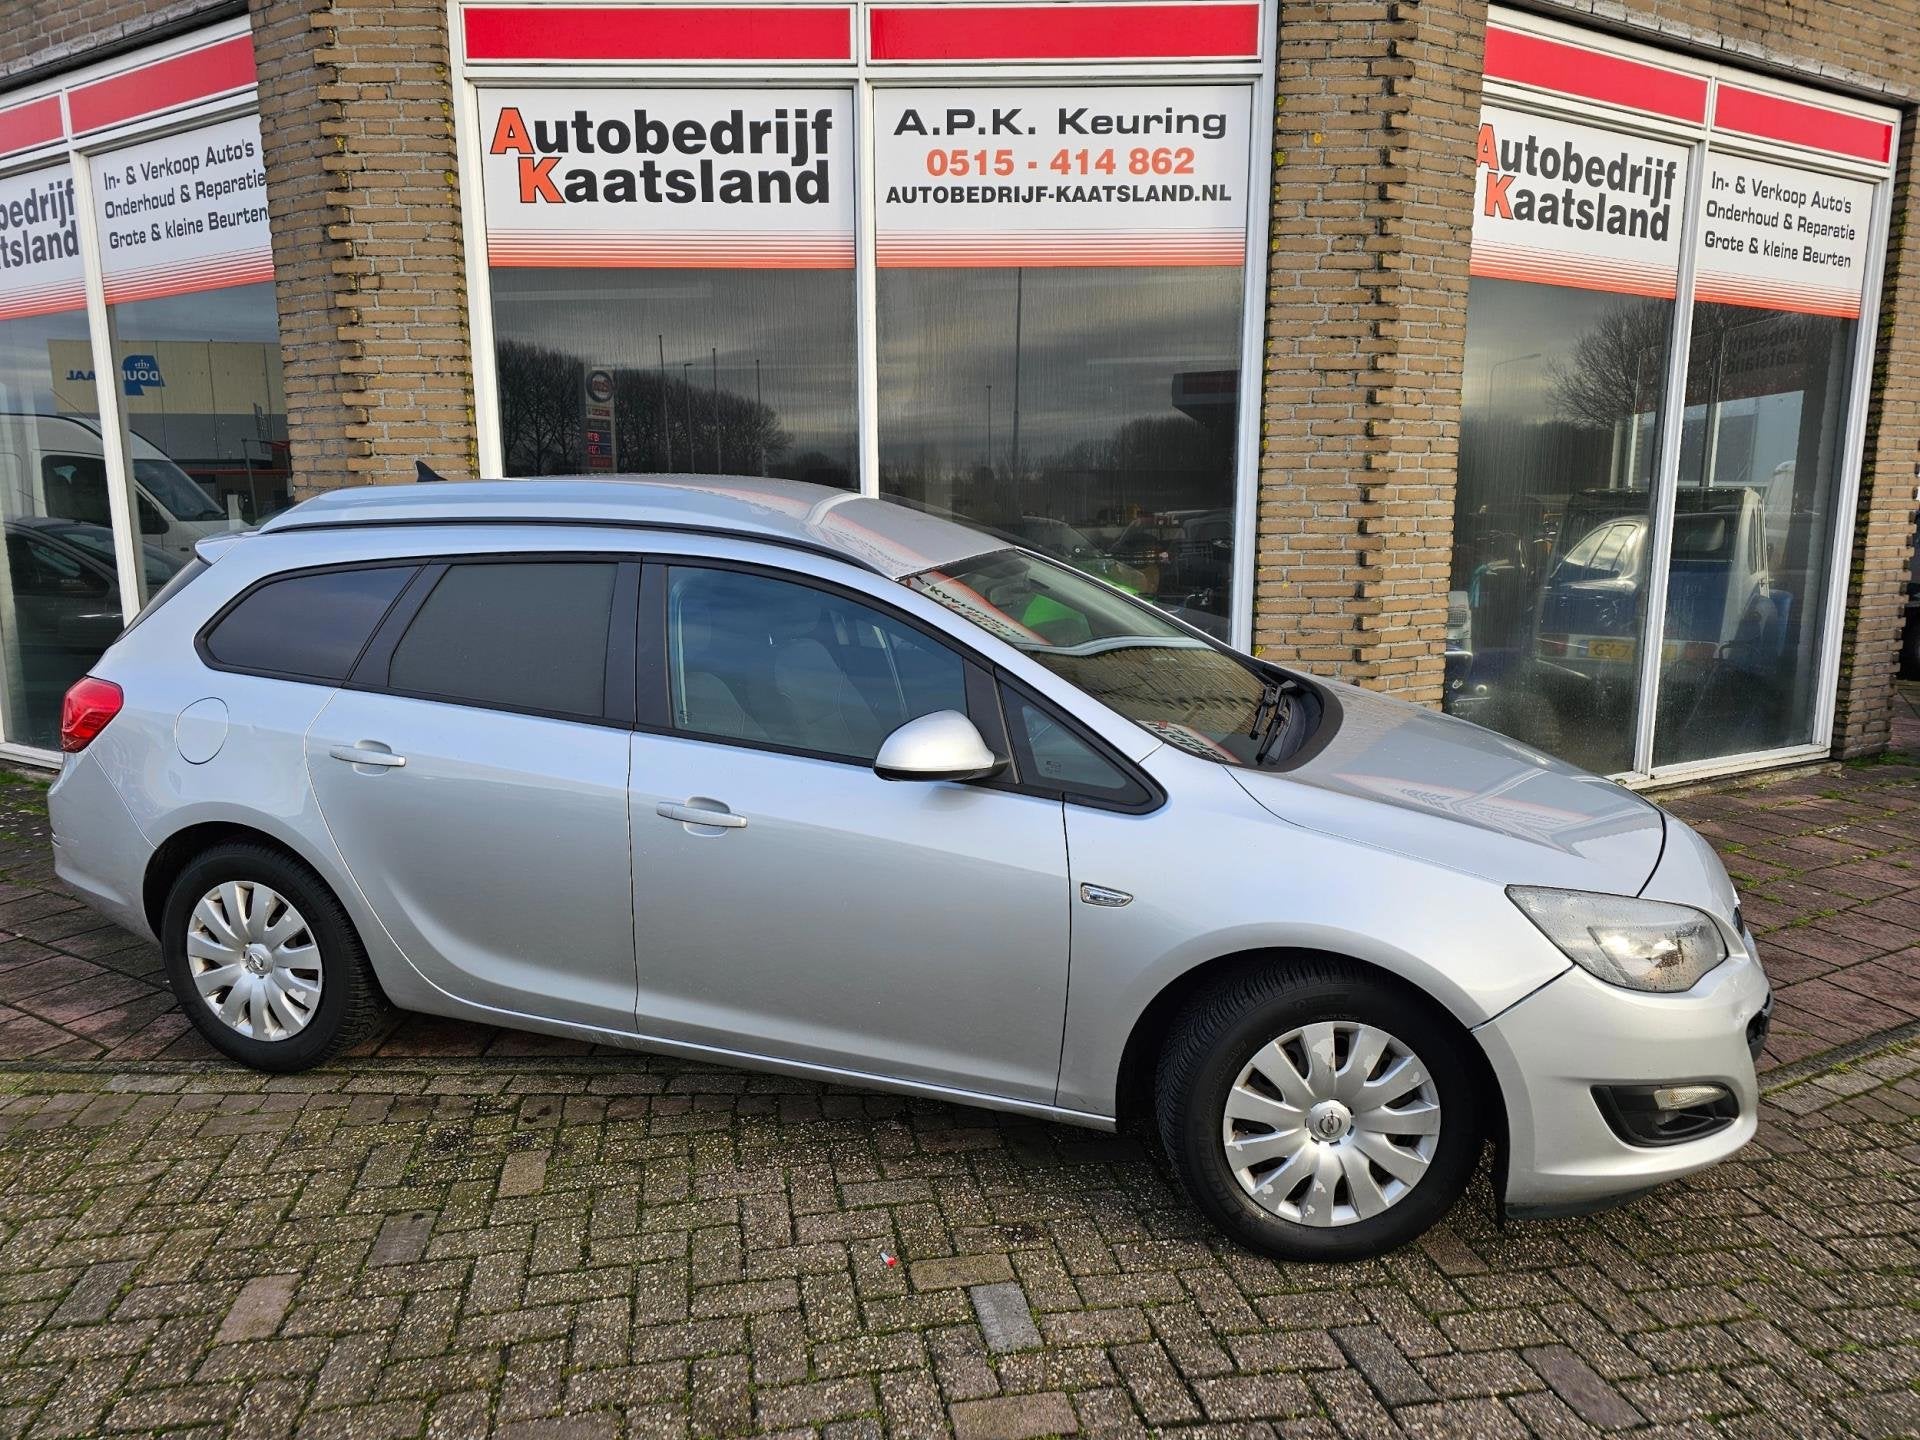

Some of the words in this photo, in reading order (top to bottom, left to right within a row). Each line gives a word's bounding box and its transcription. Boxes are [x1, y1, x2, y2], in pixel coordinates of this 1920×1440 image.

[489, 106, 832, 166] Autobedrijf
[893, 107, 1037, 136] A.P.K.
[1059, 107, 1227, 139] Keuring
[104, 172, 121, 191] In-
[126, 165, 138, 187] &
[140, 156, 200, 181] Verkoop
[206, 139, 255, 168] Auto's
[517, 156, 830, 205] Kaatsland
[926, 148, 1014, 177] 0515
[1050, 147, 1116, 176] 414
[1128, 147, 1195, 175] 862
[1476, 122, 1677, 209] Autobedrijf
[105, 187, 176, 219] Onderhoud
[181, 184, 192, 204] &
[195, 167, 266, 201] Reparatie
[885, 183, 1232, 204] AUTOBEDRIJF-KAATSLAND.NL
[1484, 172, 1671, 242] Kaatsland
[1711, 170, 1729, 191] In-
[1736, 176, 1746, 195] &
[1752, 178, 1807, 208] Verkoop
[1811, 190, 1852, 214] Auto's
[110, 229, 147, 250] Grote
[152, 223, 162, 242] &
[165, 219, 204, 240] kleine
[208, 206, 268, 232] Beurten
[1706, 199, 1779, 229] Onderhoud
[1784, 213, 1793, 230] &
[1798, 216, 1855, 241] Reparatie
[1705, 231, 1744, 253] Grote
[1749, 237, 1759, 255] &
[1763, 238, 1799, 260] kleine
[1803, 246, 1851, 268] Beurten
